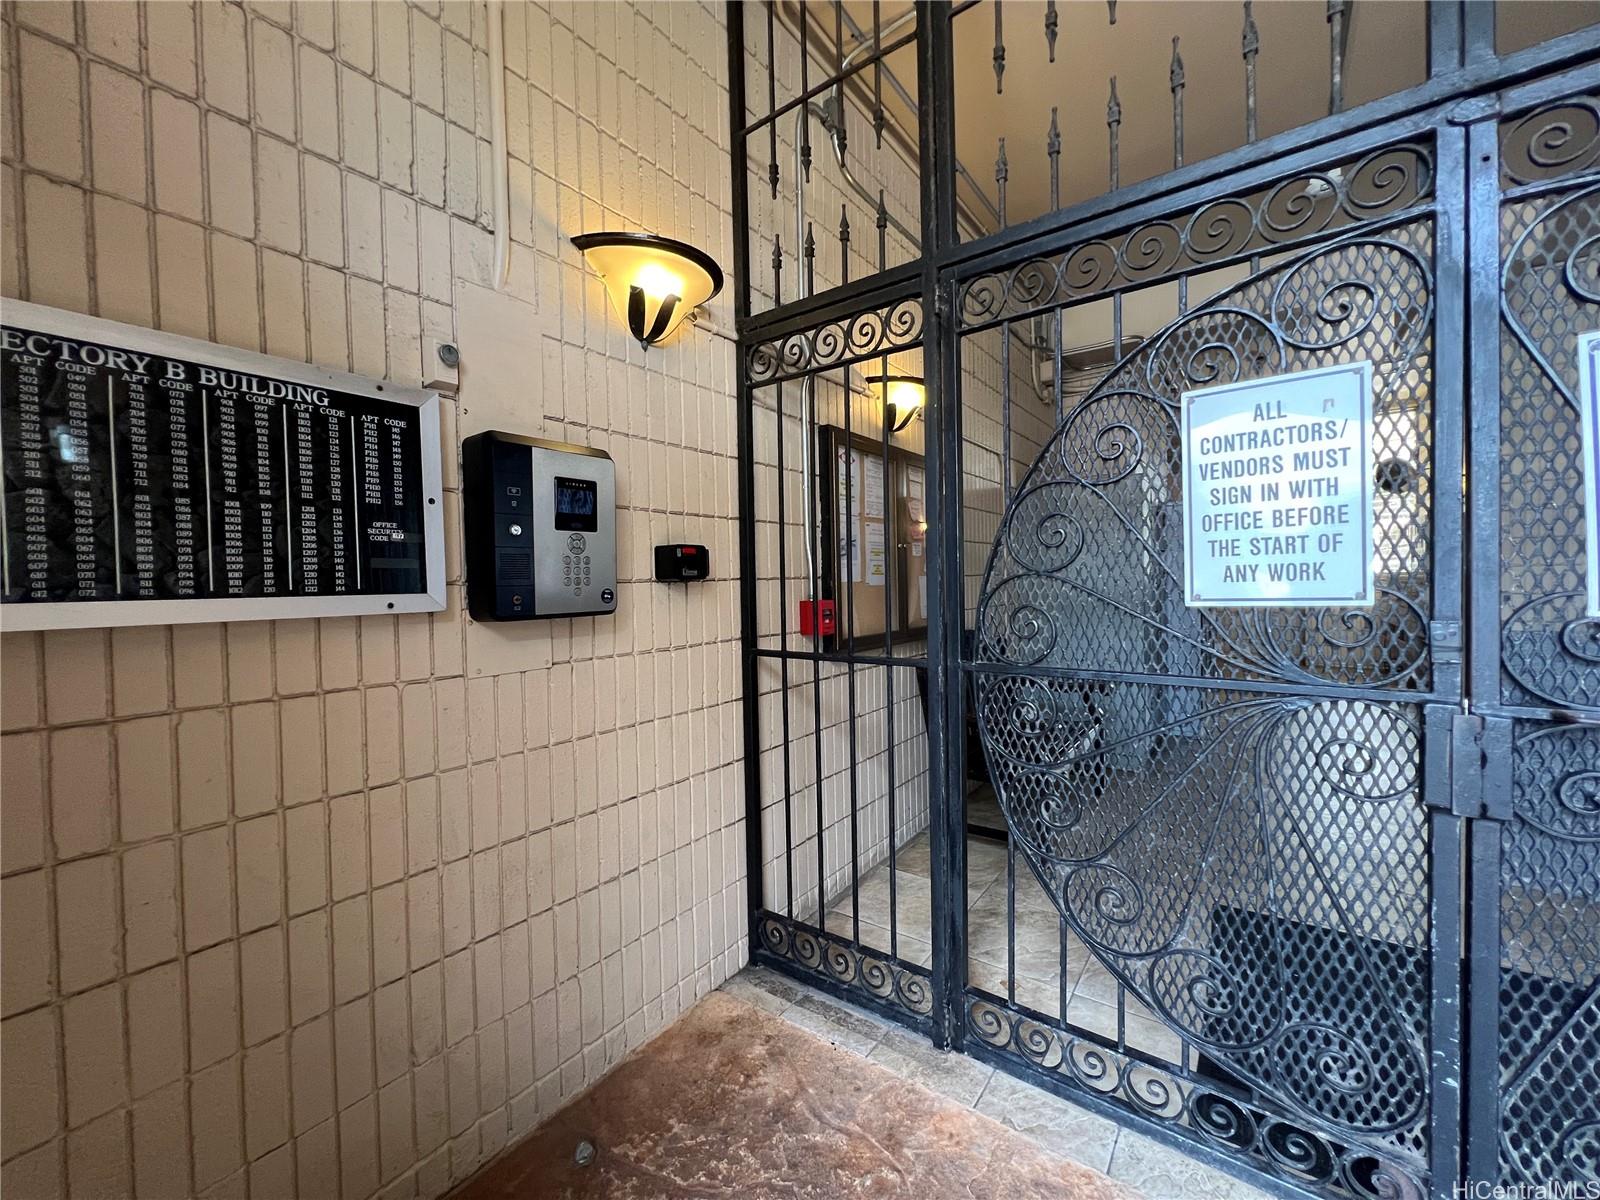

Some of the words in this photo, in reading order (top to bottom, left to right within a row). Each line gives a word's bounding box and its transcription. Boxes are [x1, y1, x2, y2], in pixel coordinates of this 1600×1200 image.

[0, 329, 150, 374] ECTORY
[164, 360, 186, 380] B
[198, 367, 330, 406] BUILDING
[11, 353, 44, 367] APT
[55, 361, 96, 375] CODE
[122, 373, 150, 384] APT
[159, 379, 193, 392] CODE
[214, 389, 238, 399] APT
[246, 394, 275, 406] CODE
[294, 403, 314, 412] APT
[320, 407, 345, 417] CODE
[361, 414, 379, 423] APT
[384, 419, 406, 428] CODE
[1253, 400, 1287, 422] ALL
[1200, 418, 1348, 456] CONTRACTORS/
[1198, 454, 1284, 481] VENDORS
[1293, 447, 1351, 472] MUST
[1210, 485, 1252, 506] SIGN
[1261, 482, 1279, 502] IN
[1289, 476, 1338, 499] WITH
[1202, 510, 1263, 532] OFFICE
[1272, 504, 1350, 528] BEFORE
[1208, 538, 1241, 558] THE
[1250, 534, 1309, 556] START
[1318, 533, 1343, 552] OF
[1224, 564, 1259, 583] ANY
[1268, 562, 1326, 582] WORK
